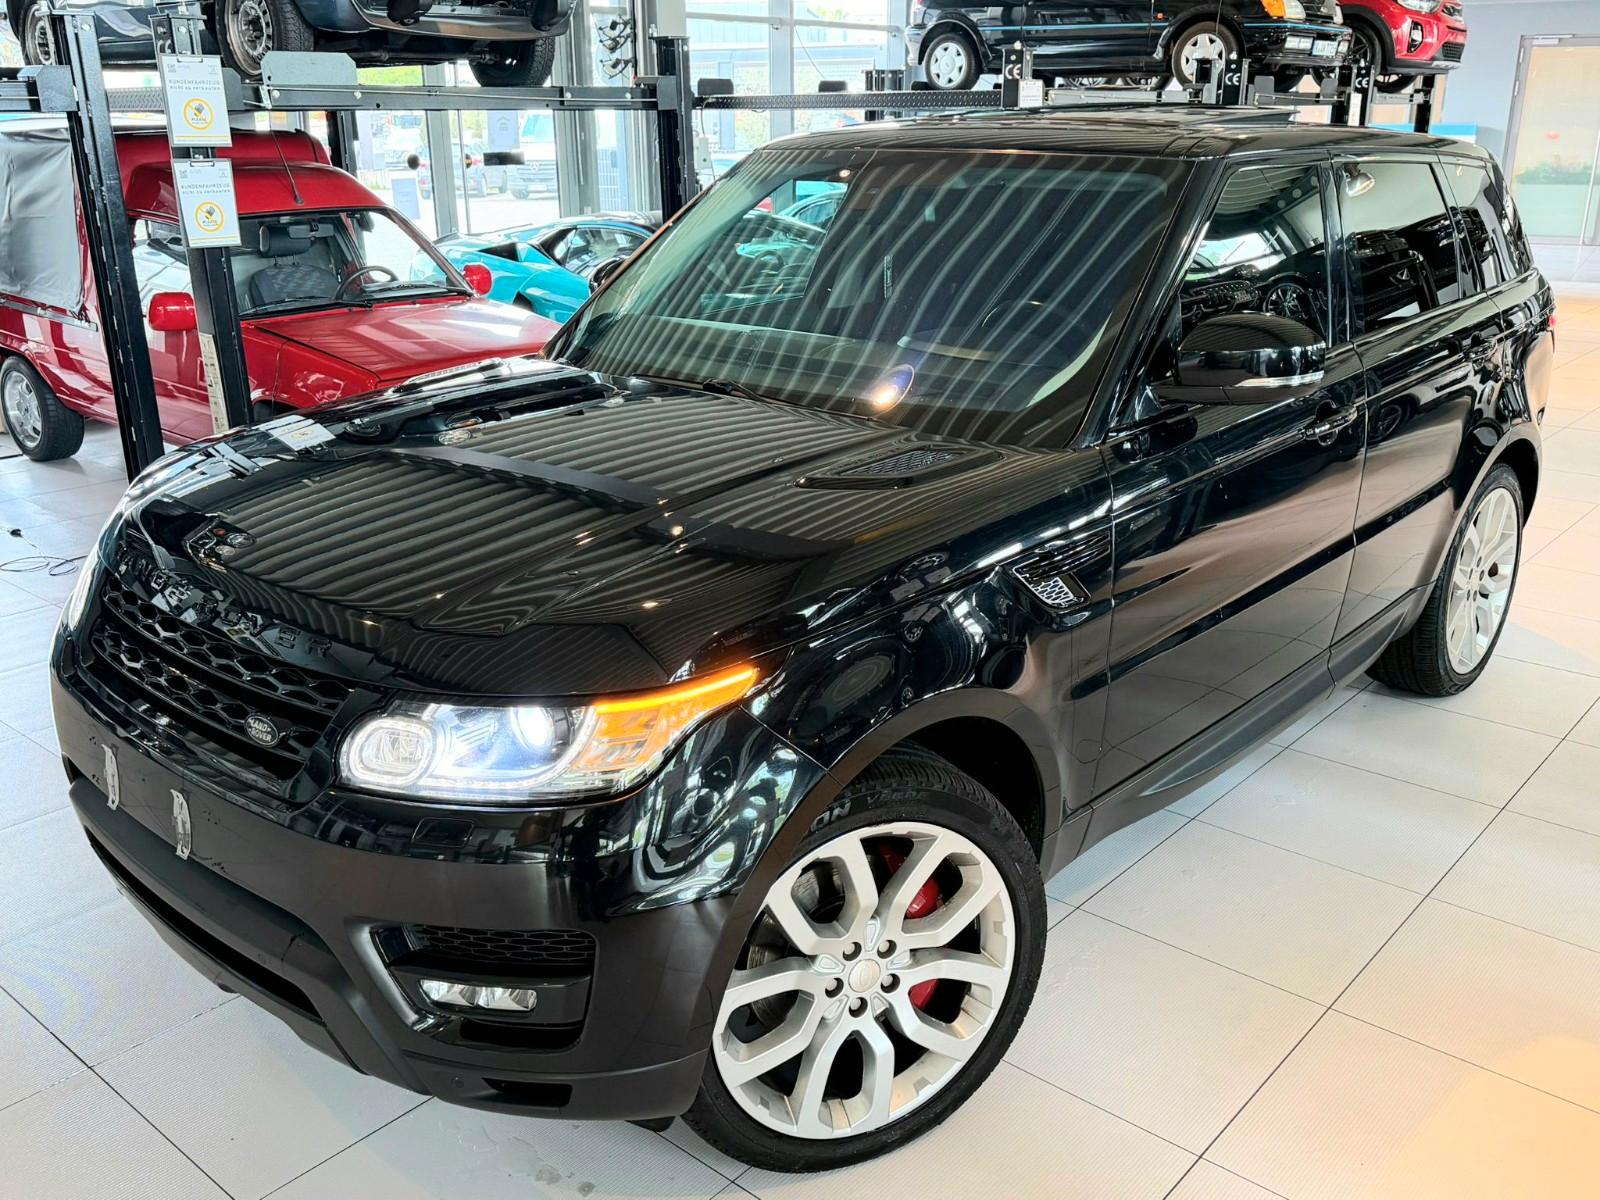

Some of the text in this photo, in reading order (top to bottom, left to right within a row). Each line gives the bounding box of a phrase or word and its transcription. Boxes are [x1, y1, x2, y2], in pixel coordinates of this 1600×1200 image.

[1005, 64, 1021, 79] CE
[1225, 73, 1241, 86] CE
[1355, 77, 1369, 88] CE
[250, 718, 268, 731] LAND
[252, 727, 272, 742] ROVER
